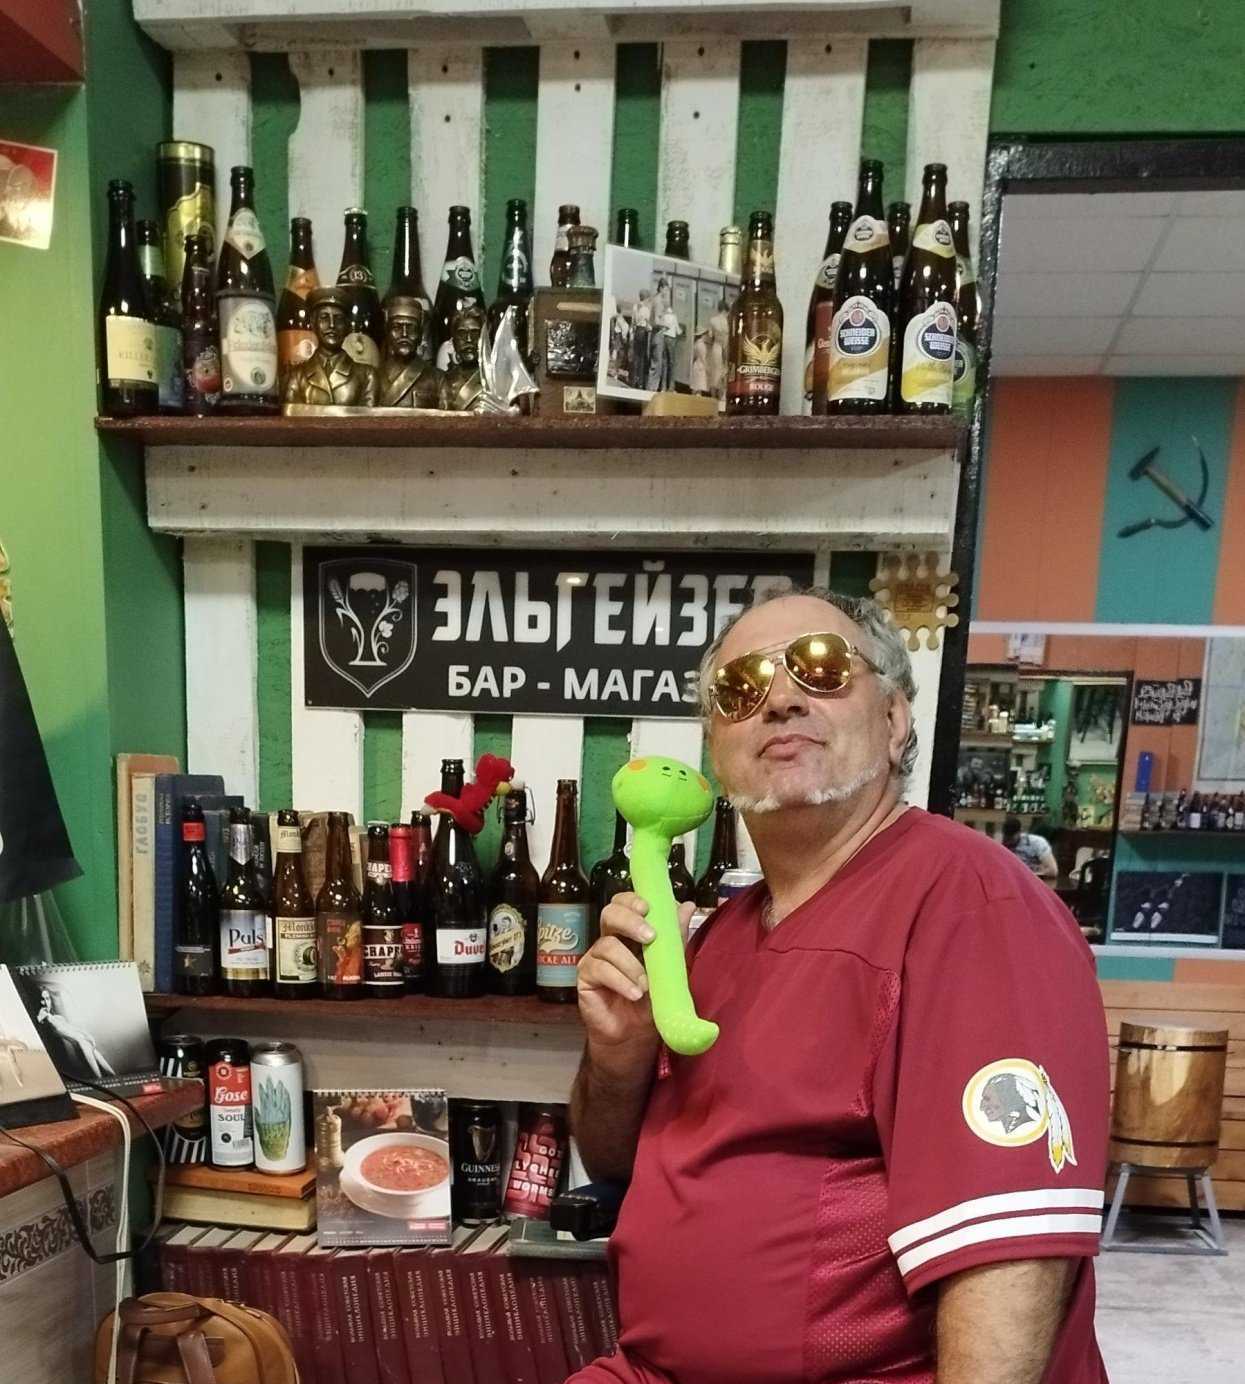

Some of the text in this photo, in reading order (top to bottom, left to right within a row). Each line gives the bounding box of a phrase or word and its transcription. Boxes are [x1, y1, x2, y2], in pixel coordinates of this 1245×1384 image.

[448, 665, 527, 698] БАР
[214, 1086, 249, 1104] Gose
[512, 1180, 554, 1198] WORMS
